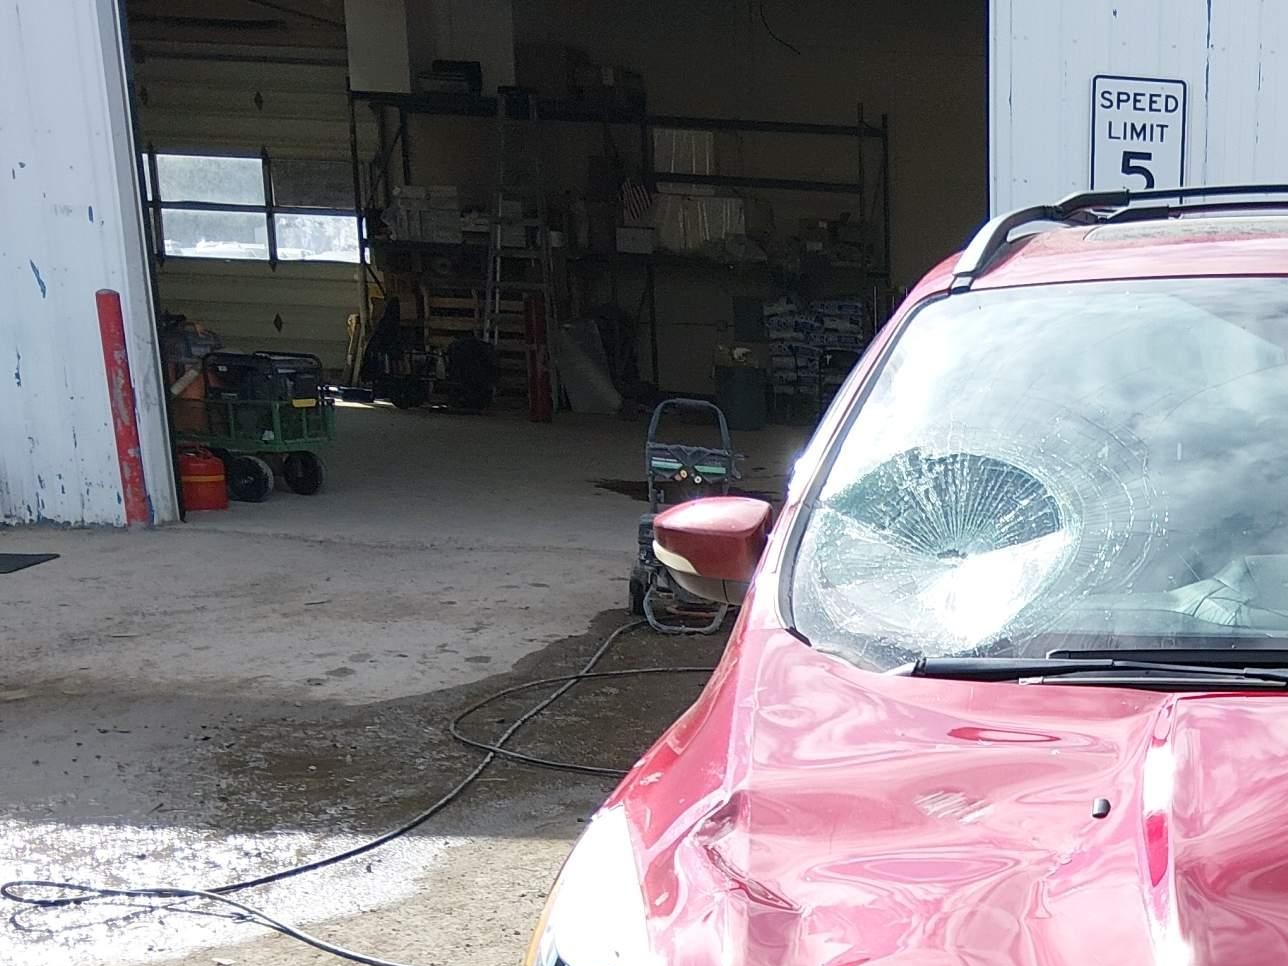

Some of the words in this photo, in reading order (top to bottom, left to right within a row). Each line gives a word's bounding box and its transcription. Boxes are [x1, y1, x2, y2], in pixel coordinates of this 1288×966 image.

[1100, 90, 1179, 113] SPEED
[1107, 120, 1169, 142] LIMIT
[1121, 151, 1155, 189] 5
